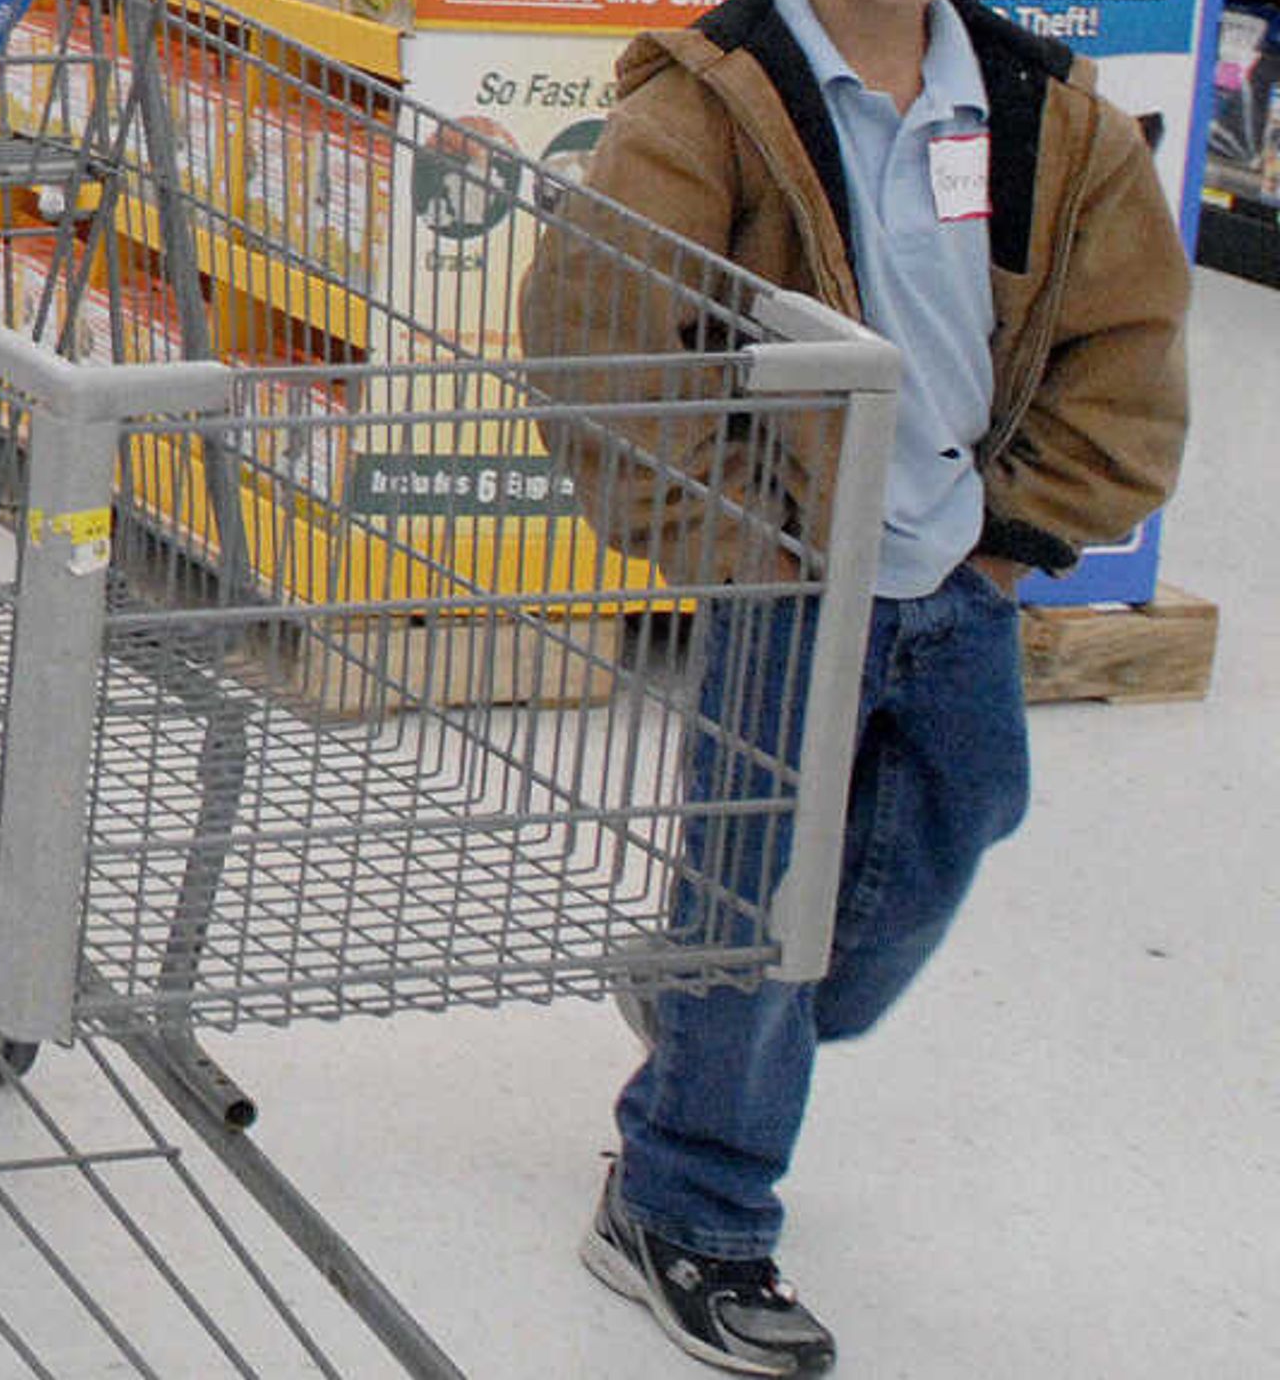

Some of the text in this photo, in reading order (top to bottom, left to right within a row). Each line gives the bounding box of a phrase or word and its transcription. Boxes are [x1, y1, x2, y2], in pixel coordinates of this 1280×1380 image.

[1016, 4, 1099, 37] Theft!
[476, 72, 516, 107] So
[526, 74, 591, 109] Fast
[477, 470, 498, 504] 6
